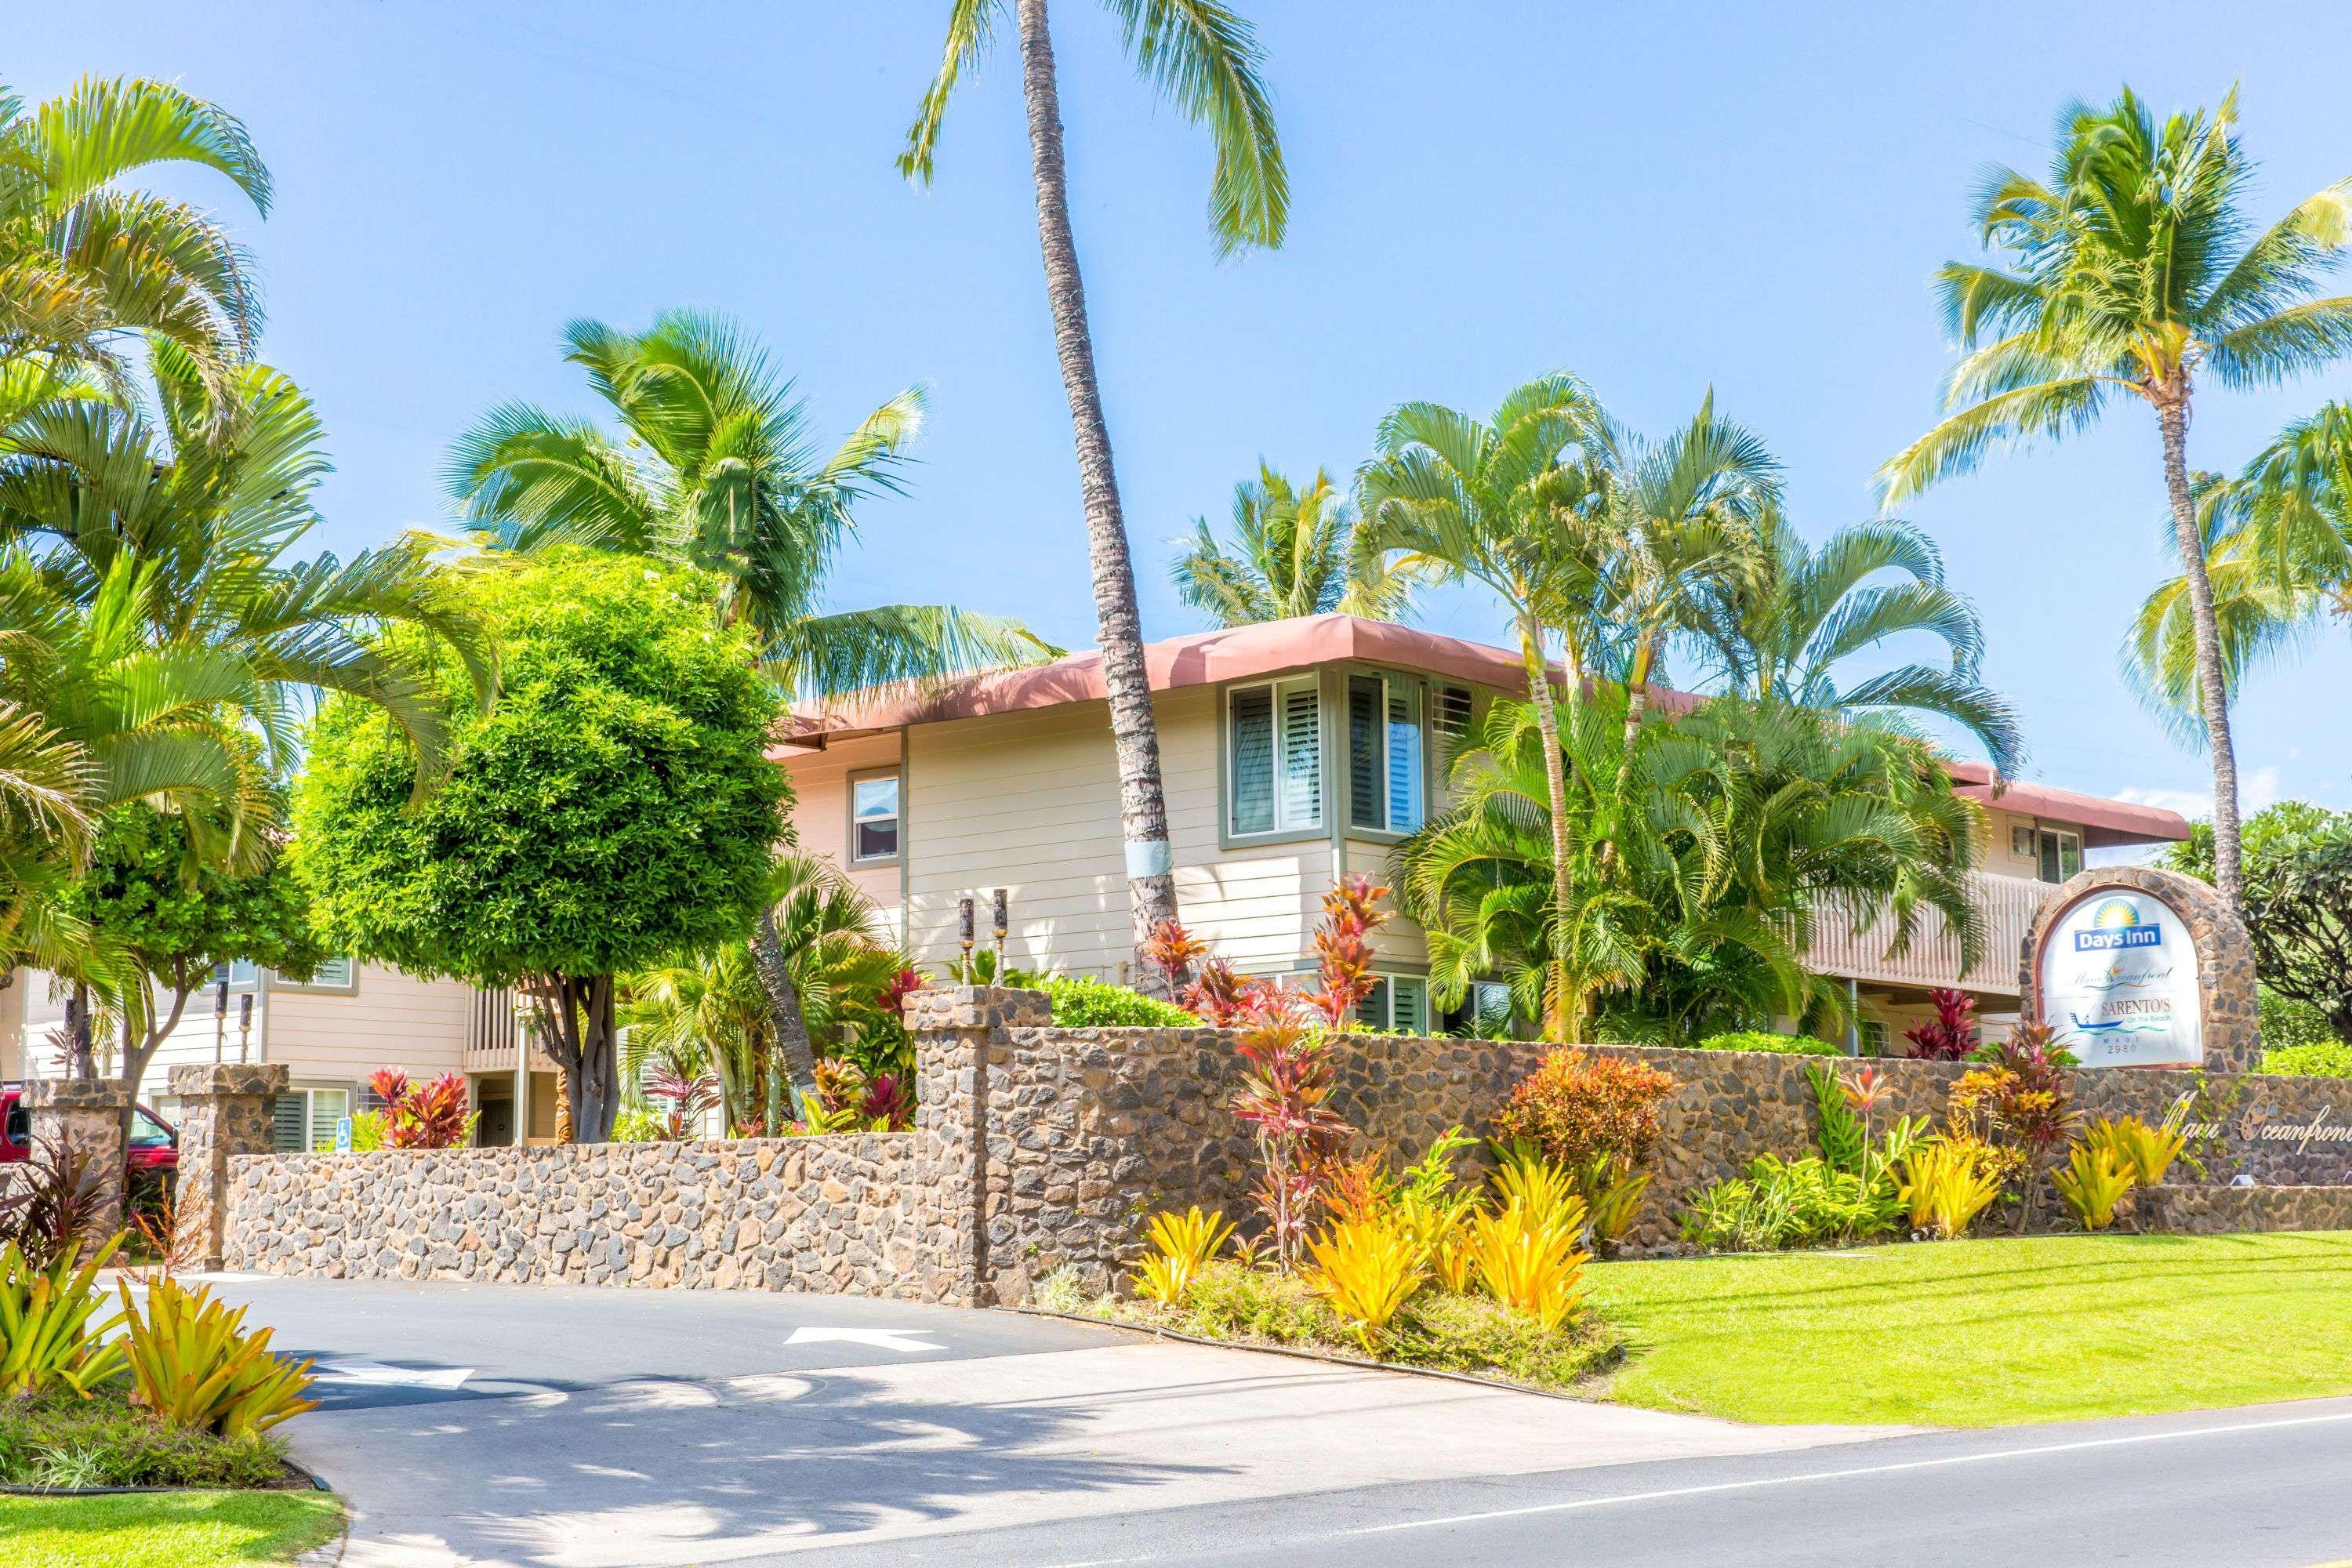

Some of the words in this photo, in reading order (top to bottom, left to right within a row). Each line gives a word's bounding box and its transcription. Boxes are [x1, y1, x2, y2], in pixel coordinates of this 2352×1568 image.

[2079, 933, 2123, 949] Days
[2126, 930, 2155, 944] Inn
[2101, 997, 2171, 1016] SARENTO'S
[2107, 1044, 2136, 1054] 2980
